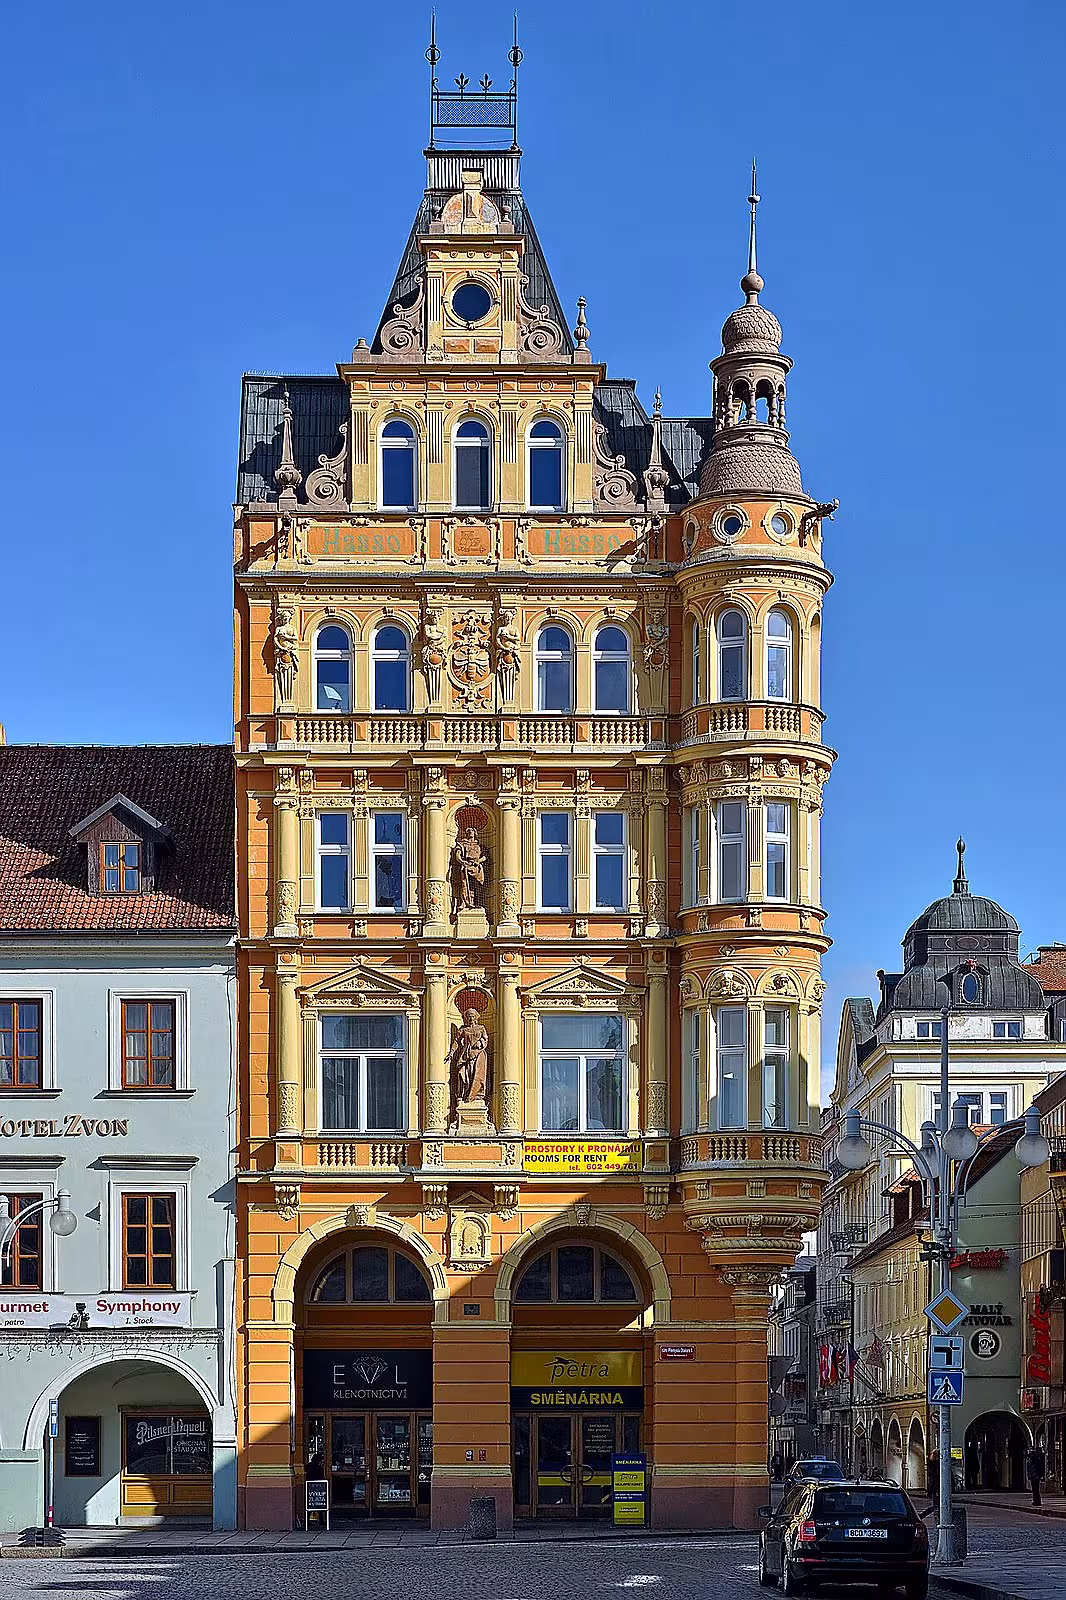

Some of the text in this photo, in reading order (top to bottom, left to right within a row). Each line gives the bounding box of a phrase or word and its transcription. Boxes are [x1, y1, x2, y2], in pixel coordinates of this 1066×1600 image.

[324, 528, 400, 552] Hasso
[545, 529, 620, 554] Hasso
[0, 1116, 62, 1137] OTEL
[524, 1143, 641, 1153] PROSTORY K PRONÁJMU
[524, 1154, 608, 1163] ROOMS FOR RENT
[623, 1162, 639, 1170] 761
[96, 1299, 182, 1315] Symphony
[969, 1301, 1004, 1316] MALÝ
[133, 1316, 154, 1325] Stock
[549, 1361, 610, 1384] petra
[333, 1388, 408, 1399] KLENOTNICTVÍ
[530, 1390, 624, 1405] SMĚNÁRNA
[166, 1446, 208, 1454] RSTAURANT
